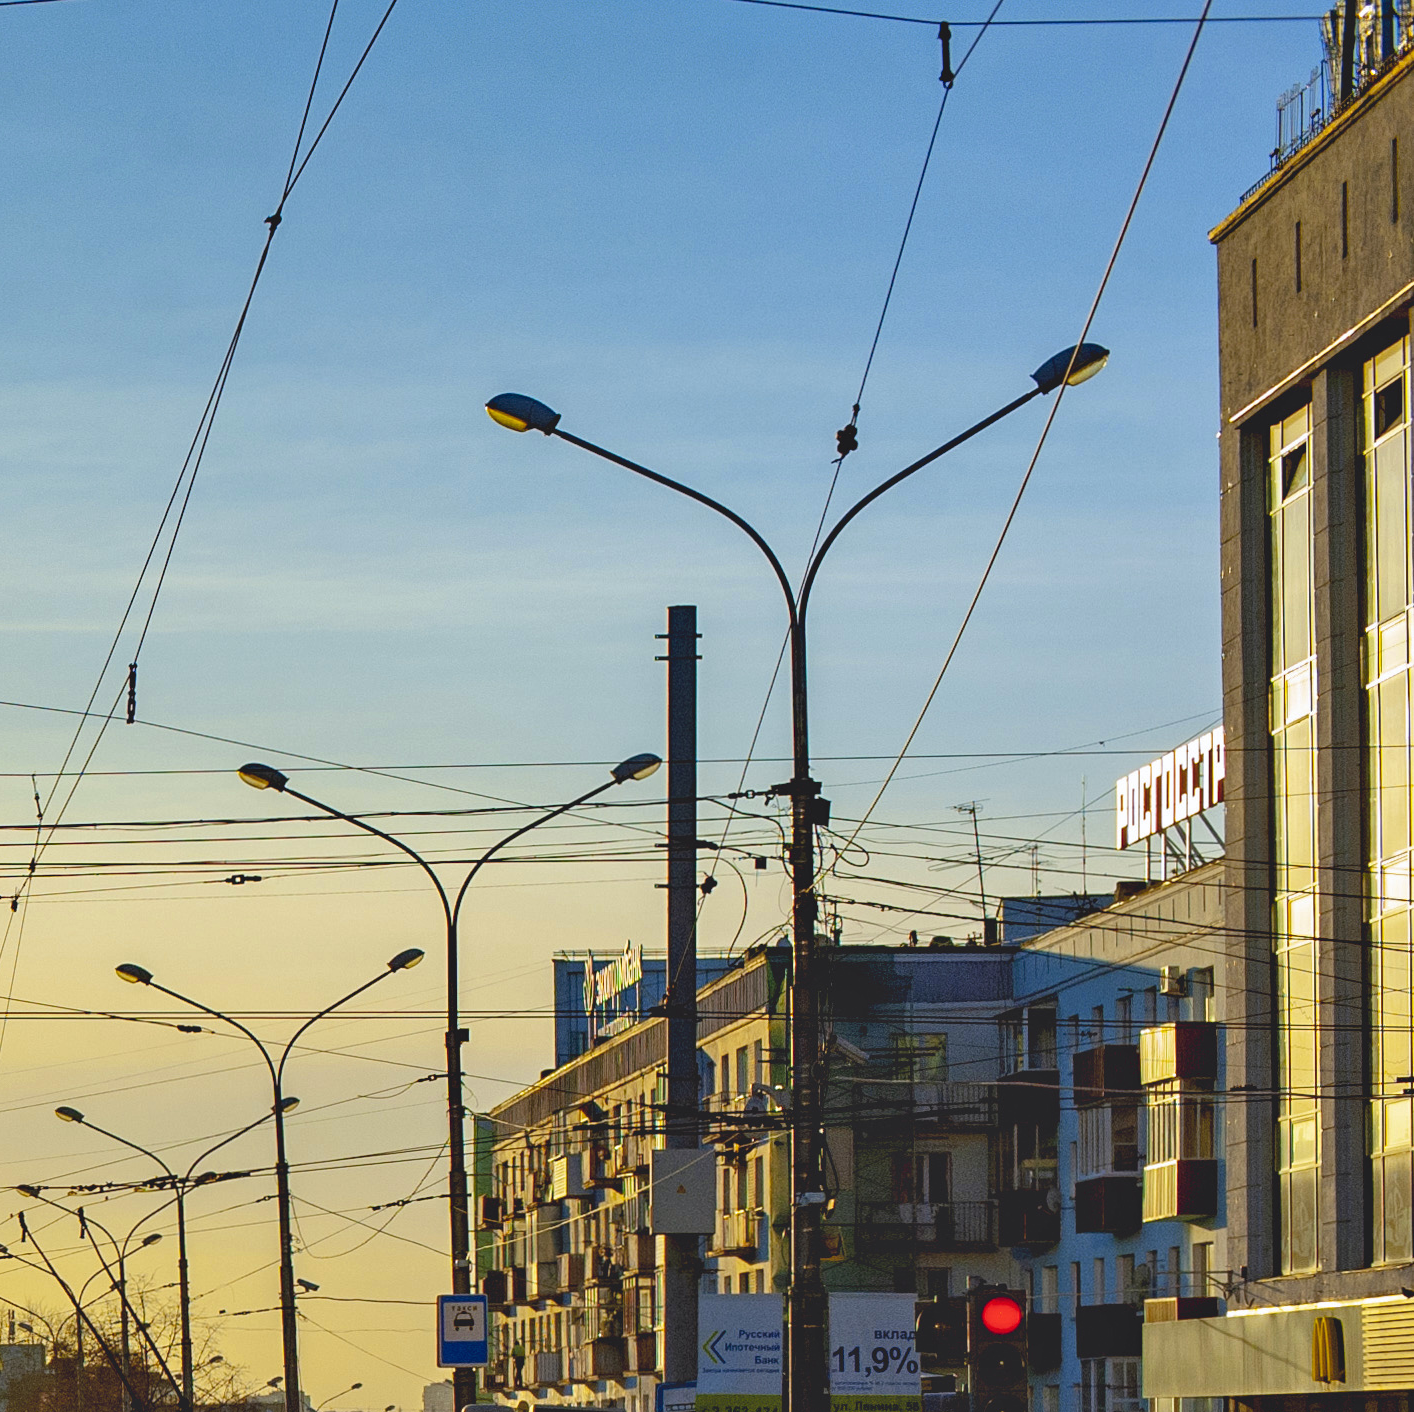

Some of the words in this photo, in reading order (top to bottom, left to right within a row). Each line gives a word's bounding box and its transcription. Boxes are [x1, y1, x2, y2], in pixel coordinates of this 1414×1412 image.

[1116, 726, 1226, 850] РОСГОССТР
[739, 1329, 780, 1340] Русский
[725, 1342, 780, 1352] Ипотечный
[755, 1356, 779, 1364] Банк
[833, 1346, 918, 1377] 11,9%
